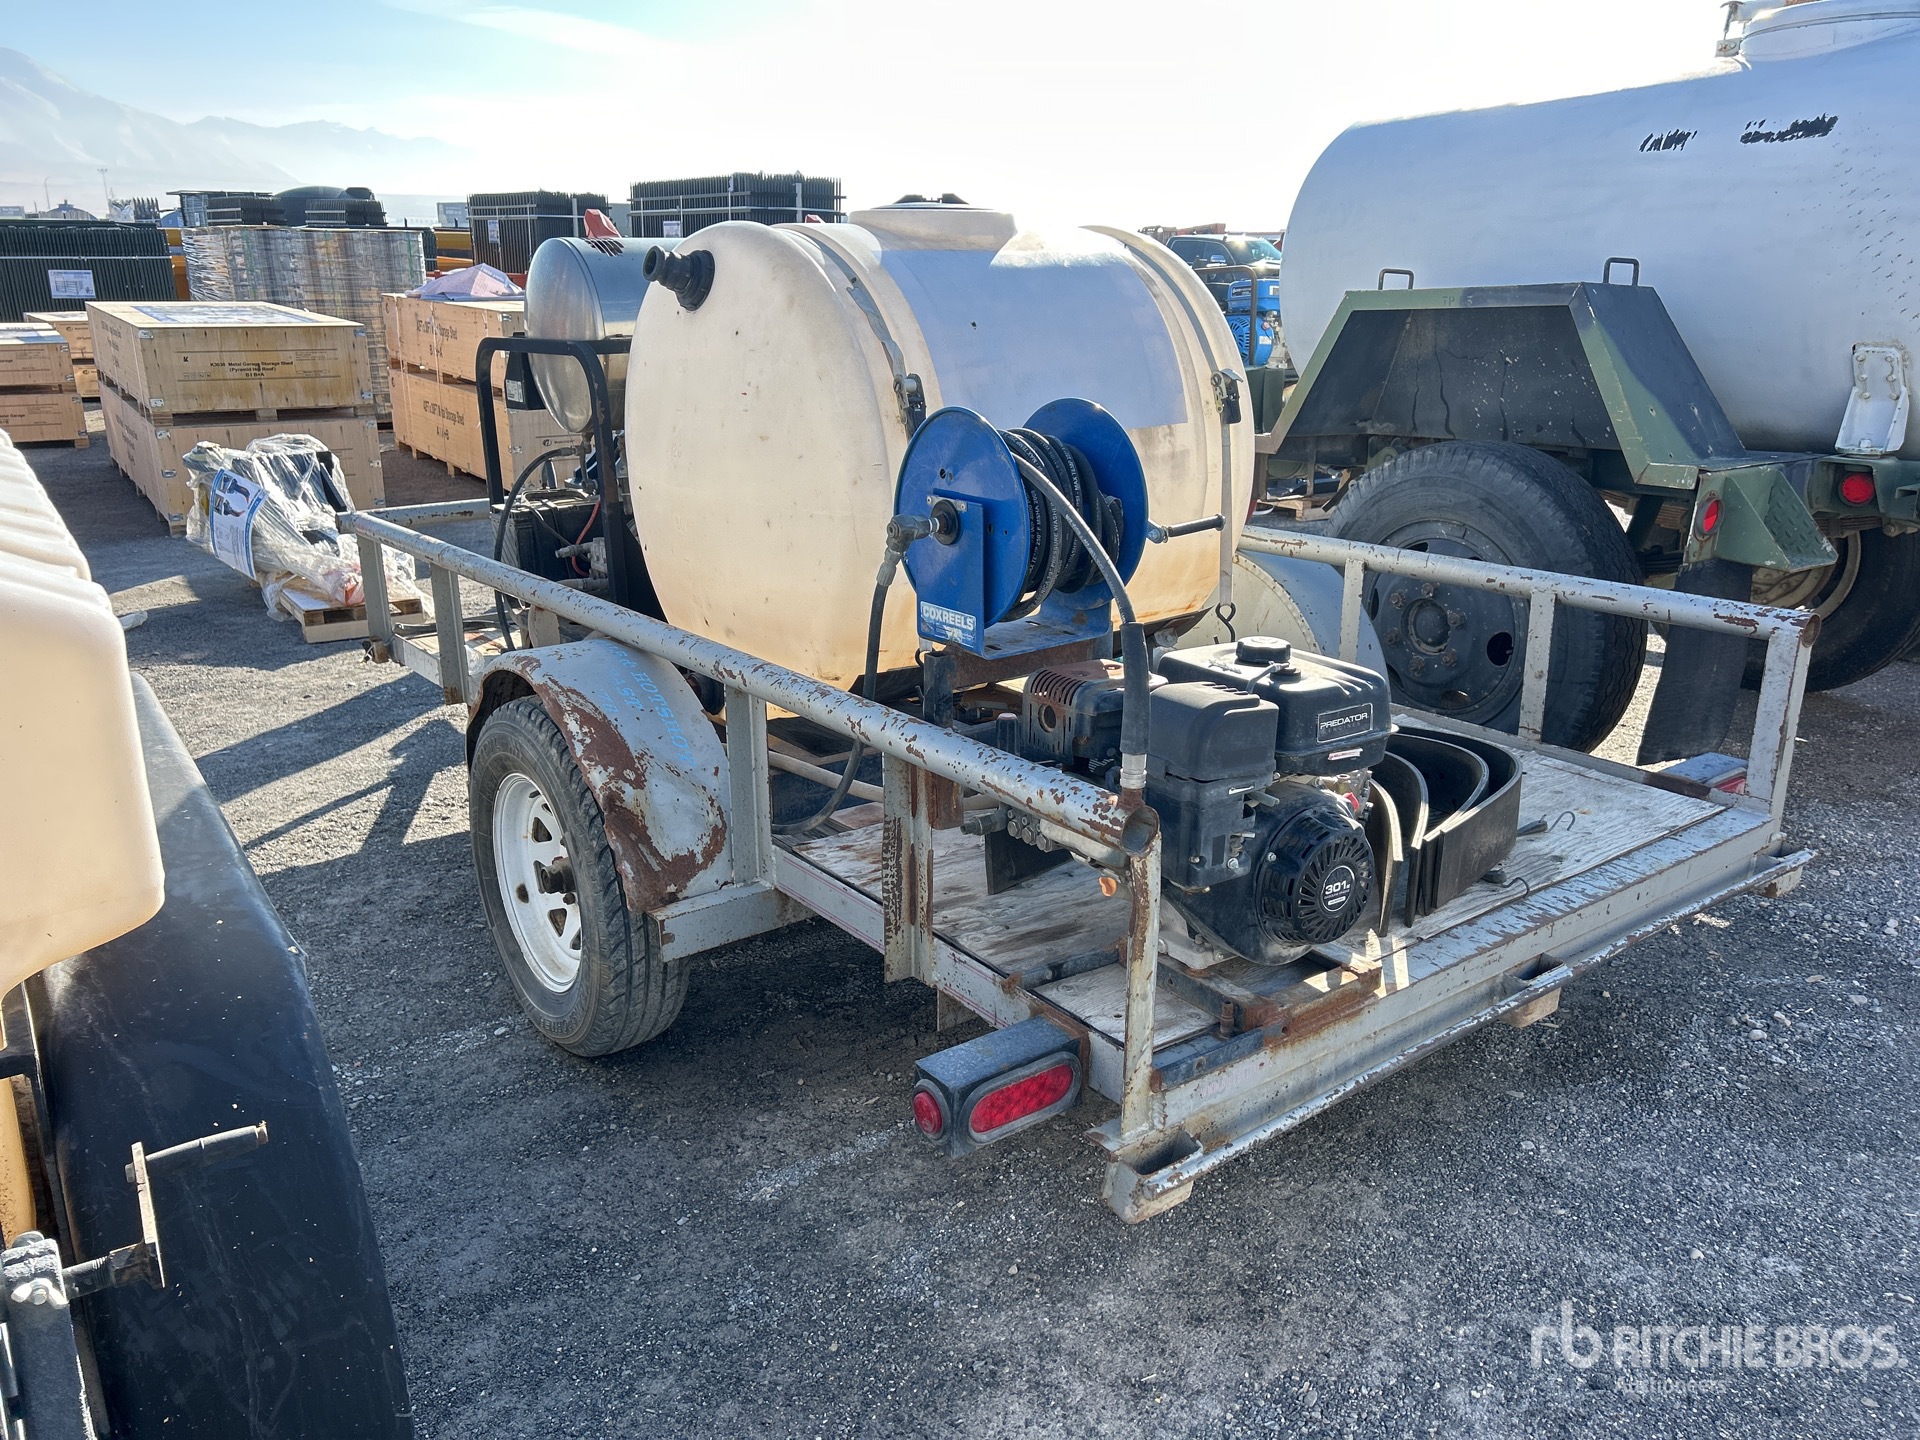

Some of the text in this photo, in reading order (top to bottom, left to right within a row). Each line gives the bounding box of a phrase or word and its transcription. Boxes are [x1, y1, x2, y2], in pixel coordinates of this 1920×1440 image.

[1050, 533, 1058, 567] PRESSURE
[922, 604, 974, 631] COXREELS
[1320, 712, 1368, 730] PREDATOR
